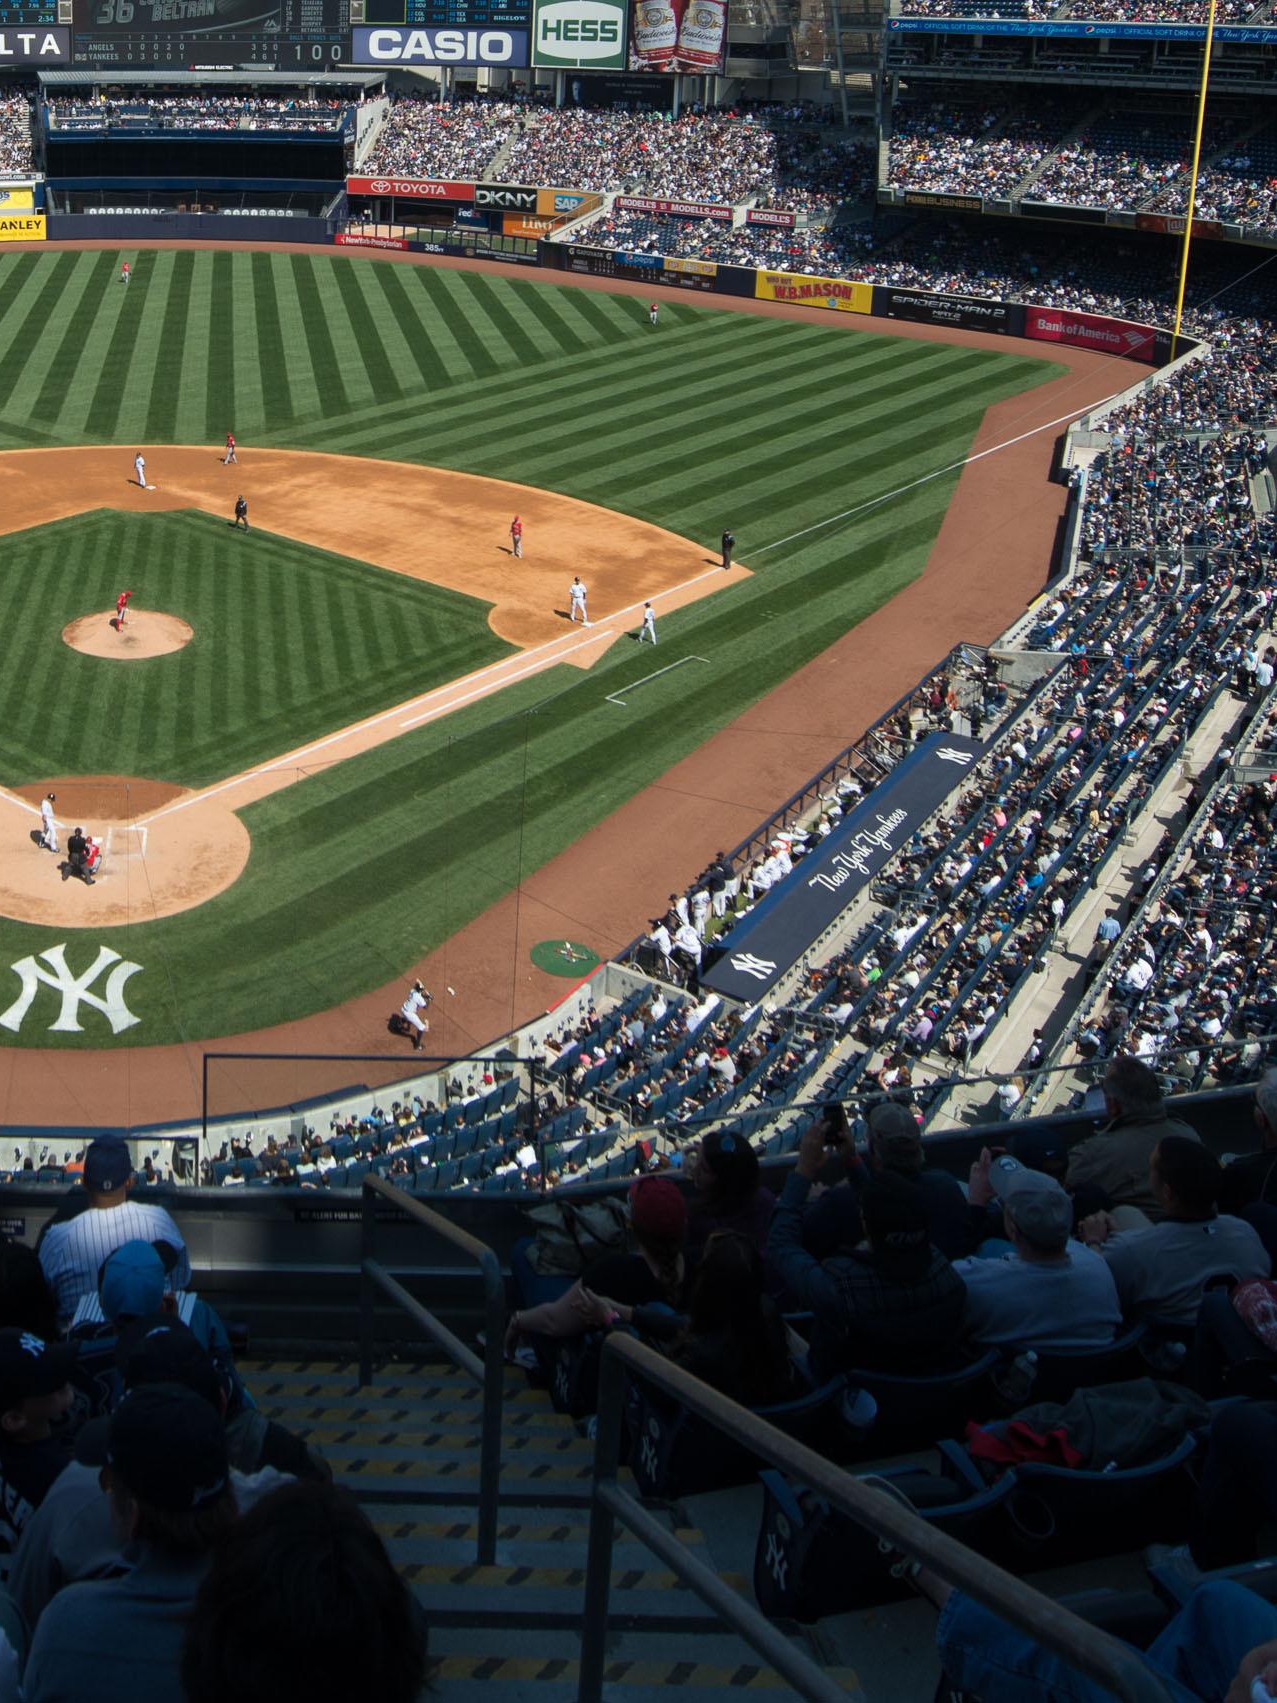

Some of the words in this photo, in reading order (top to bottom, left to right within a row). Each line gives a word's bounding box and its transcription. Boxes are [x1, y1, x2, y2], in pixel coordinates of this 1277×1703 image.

[97, 0, 134, 24] 36
[151, 0, 215, 22] BELTRAN
[542, 19, 618, 42] HESS
[1011, 23, 1027, 32] New
[1027, 24, 1045, 35] York
[1047, 25, 1078, 35] Yankees
[1223, 29, 1238, 38] New
[1241, 29, 1259, 41] York
[295, 45, 301, 60] 1
[312, 45, 322, 60] 0
[331, 45, 341, 60] 0
[369, 30, 513, 61] CASIO
[393, 182, 446, 195] TOYOTA
[476, 190, 537, 207] DKNY
[555, 198, 578, 209] SAP
[927, 197, 981, 209] BUSINESS
[459, 208, 480, 218] FedEx
[620, 199, 657, 209] MODELL'S
[671, 204, 729, 217] MODELLS.com
[751, 212, 790, 223] MODELL'S
[576, 250, 603, 258] GATORADE
[774, 284, 852, 300] W.B.MASON
[892, 296, 992, 316] SPIDER-MAN
[993, 308, 1005, 317] 2
[1038, 319, 1065, 332] Bank
[1066, 324, 1078, 334] of
[1078, 326, 1120, 343] America
[808, 866, 851, 892] New
[831, 830, 873, 874] York
[865, 808, 908, 851] Yankees
